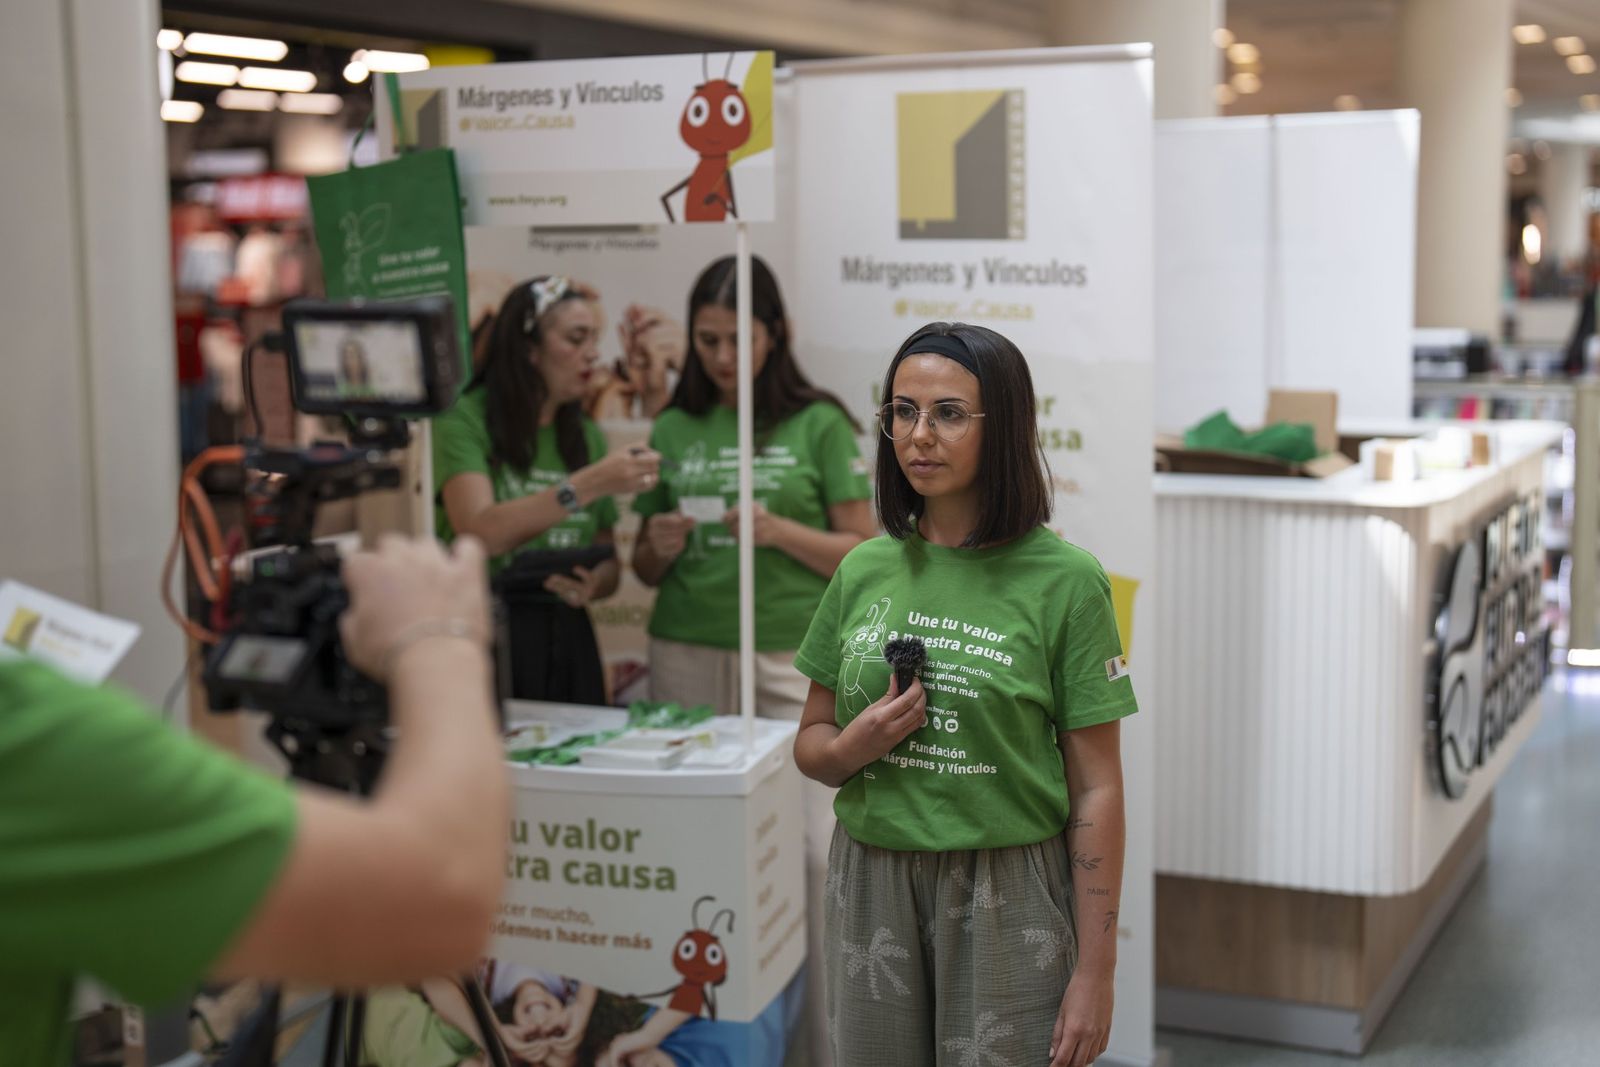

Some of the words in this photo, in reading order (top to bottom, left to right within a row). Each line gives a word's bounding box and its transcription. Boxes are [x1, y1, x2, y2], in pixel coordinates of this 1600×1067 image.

[560, 88, 572, 109] y
[962, 263, 976, 290] y
[907, 611, 939, 628] Une
[942, 616, 959, 630] tu
[962, 622, 1007, 643] valor
[888, 630, 898, 641] a
[965, 643, 1013, 667] causa
[936, 660, 958, 670] hacer
[958, 687, 979, 698] más
[909, 741, 966, 759] Fundación
[938, 763, 946, 774] y
[947, 762, 997, 775] Vínculos
[538, 817, 642, 853] valor
[562, 859, 677, 891] causa
[557, 926, 608, 946] hacer
[612, 932, 653, 951] más
